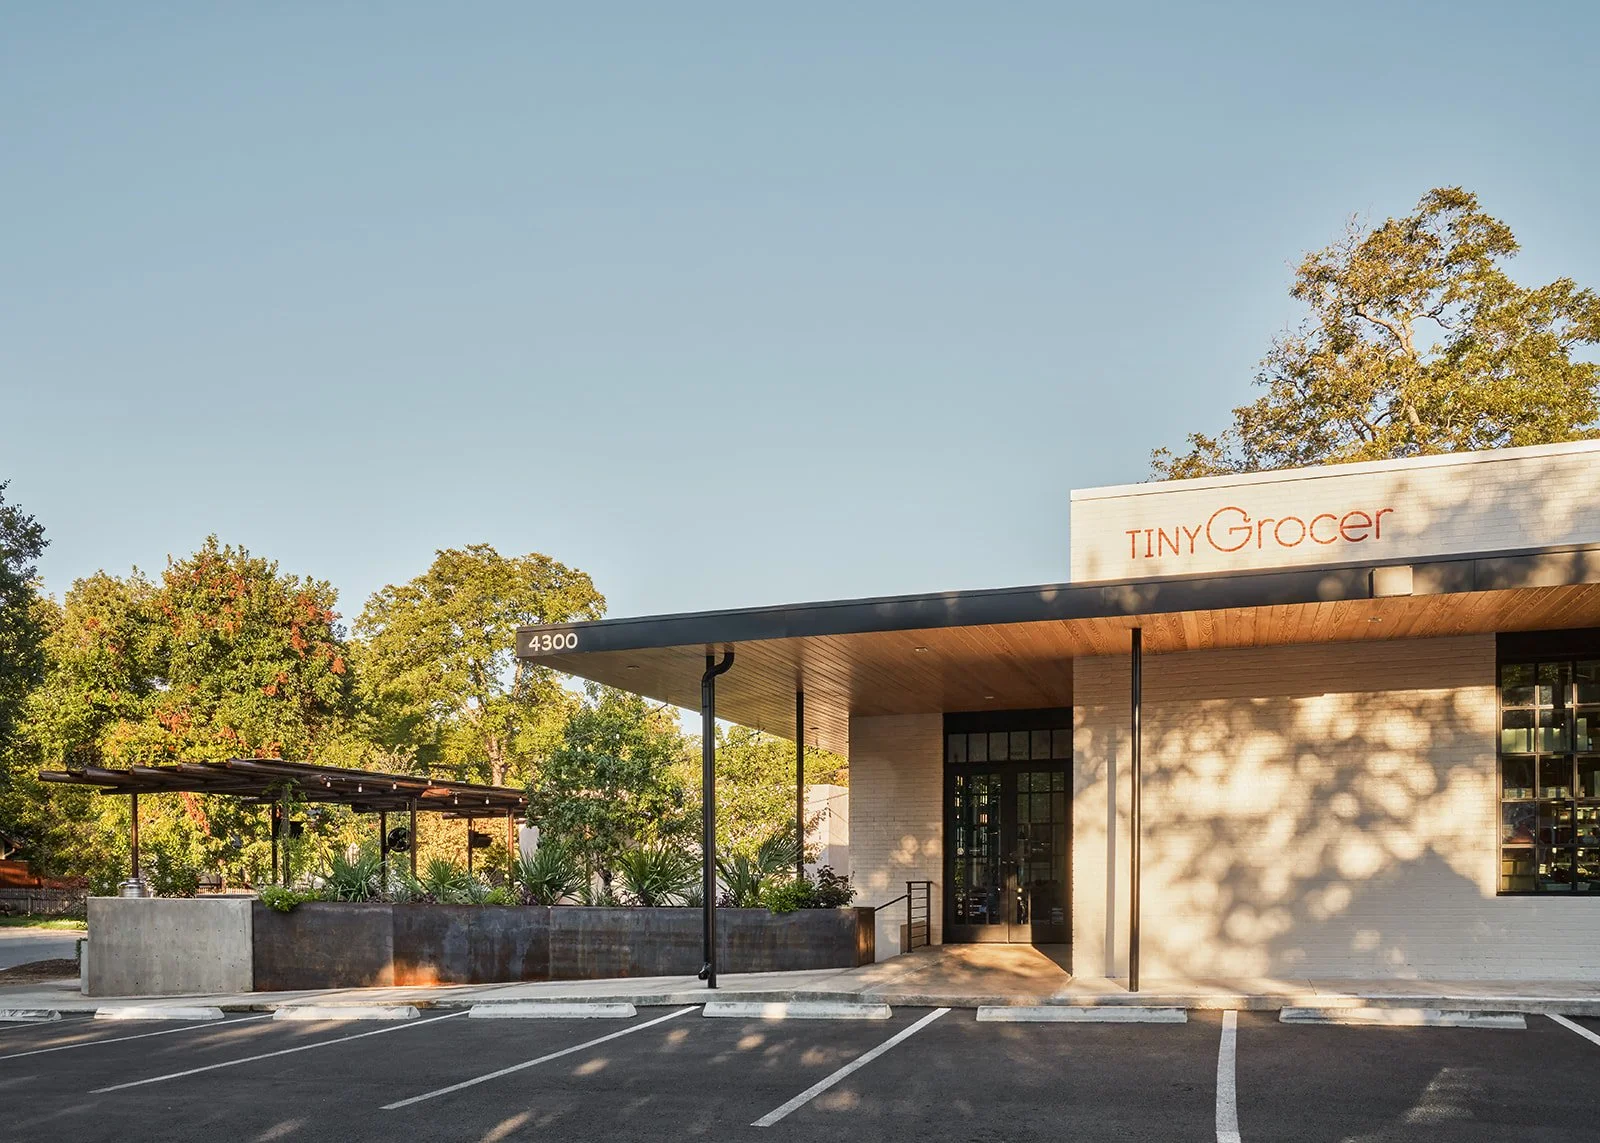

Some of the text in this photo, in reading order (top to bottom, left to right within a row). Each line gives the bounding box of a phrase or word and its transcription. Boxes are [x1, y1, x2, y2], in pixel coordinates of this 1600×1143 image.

[1126, 506, 1394, 559] TINY Grocer
[528, 632, 578, 651] 4300
